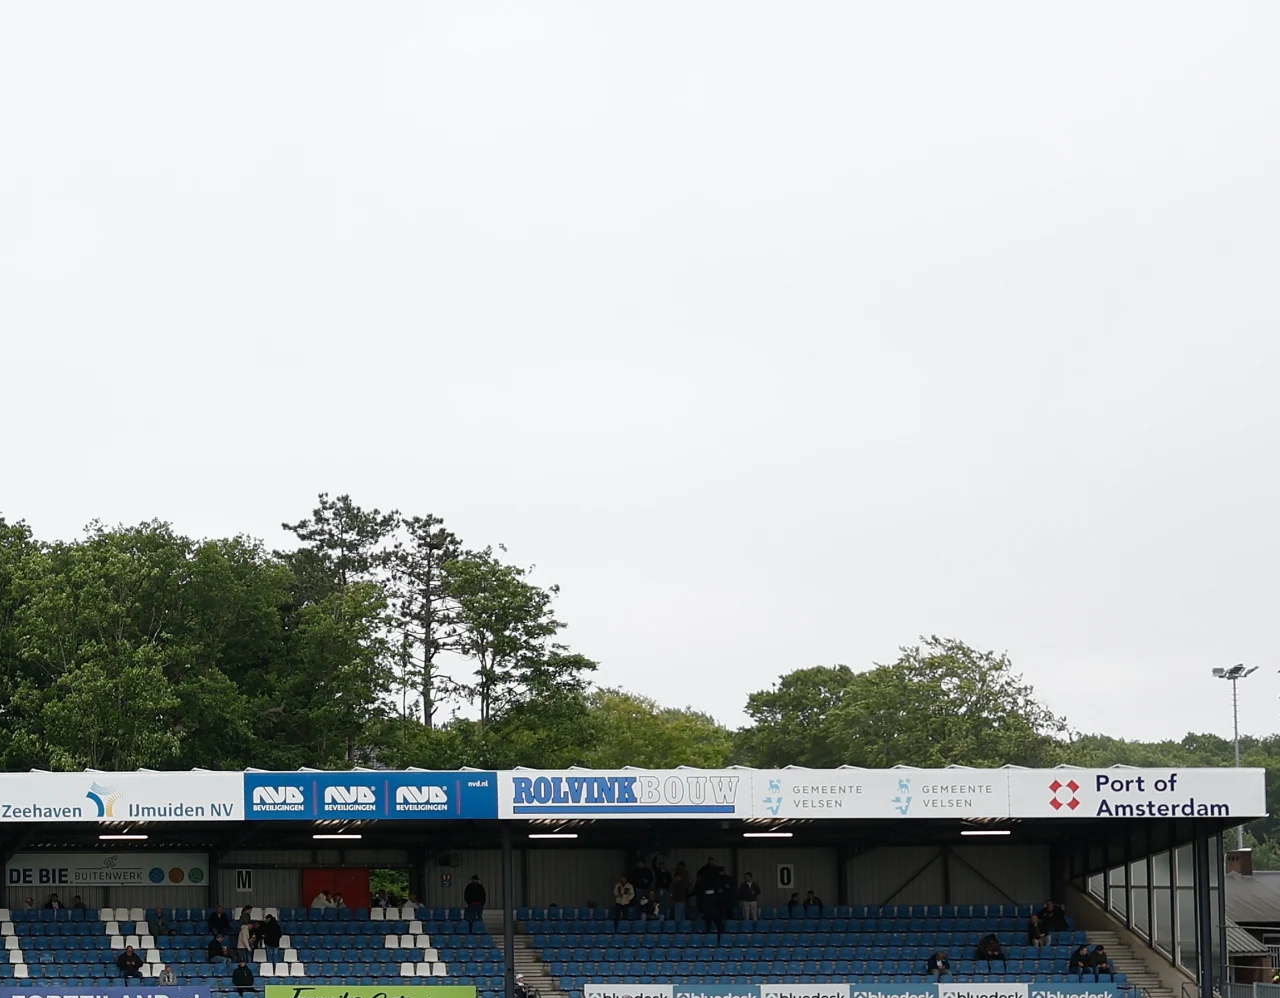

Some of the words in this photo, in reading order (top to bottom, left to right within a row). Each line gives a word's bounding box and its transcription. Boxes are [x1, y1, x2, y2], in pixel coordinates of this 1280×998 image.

[467, 780, 489, 788] nvd.nl
[1095, 774, 1145, 792] Port
[1154, 773, 1178, 792] of
[792, 785, 863, 794] GEMEENTE
[922, 785, 993, 794] GEMEENTE
[793, 799, 843, 808] VELSEN
[922, 799, 972, 808] VELSEN
[1096, 798, 1230, 817] Amsterdam
[2, 804, 82, 819] Zeehaven
[129, 803, 204, 818] IJmuiden
[210, 803, 233, 816] NV
[9, 868, 33, 884] DE
[74, 871, 143, 881] BUITENWERK
[237, 871, 251, 889] M
